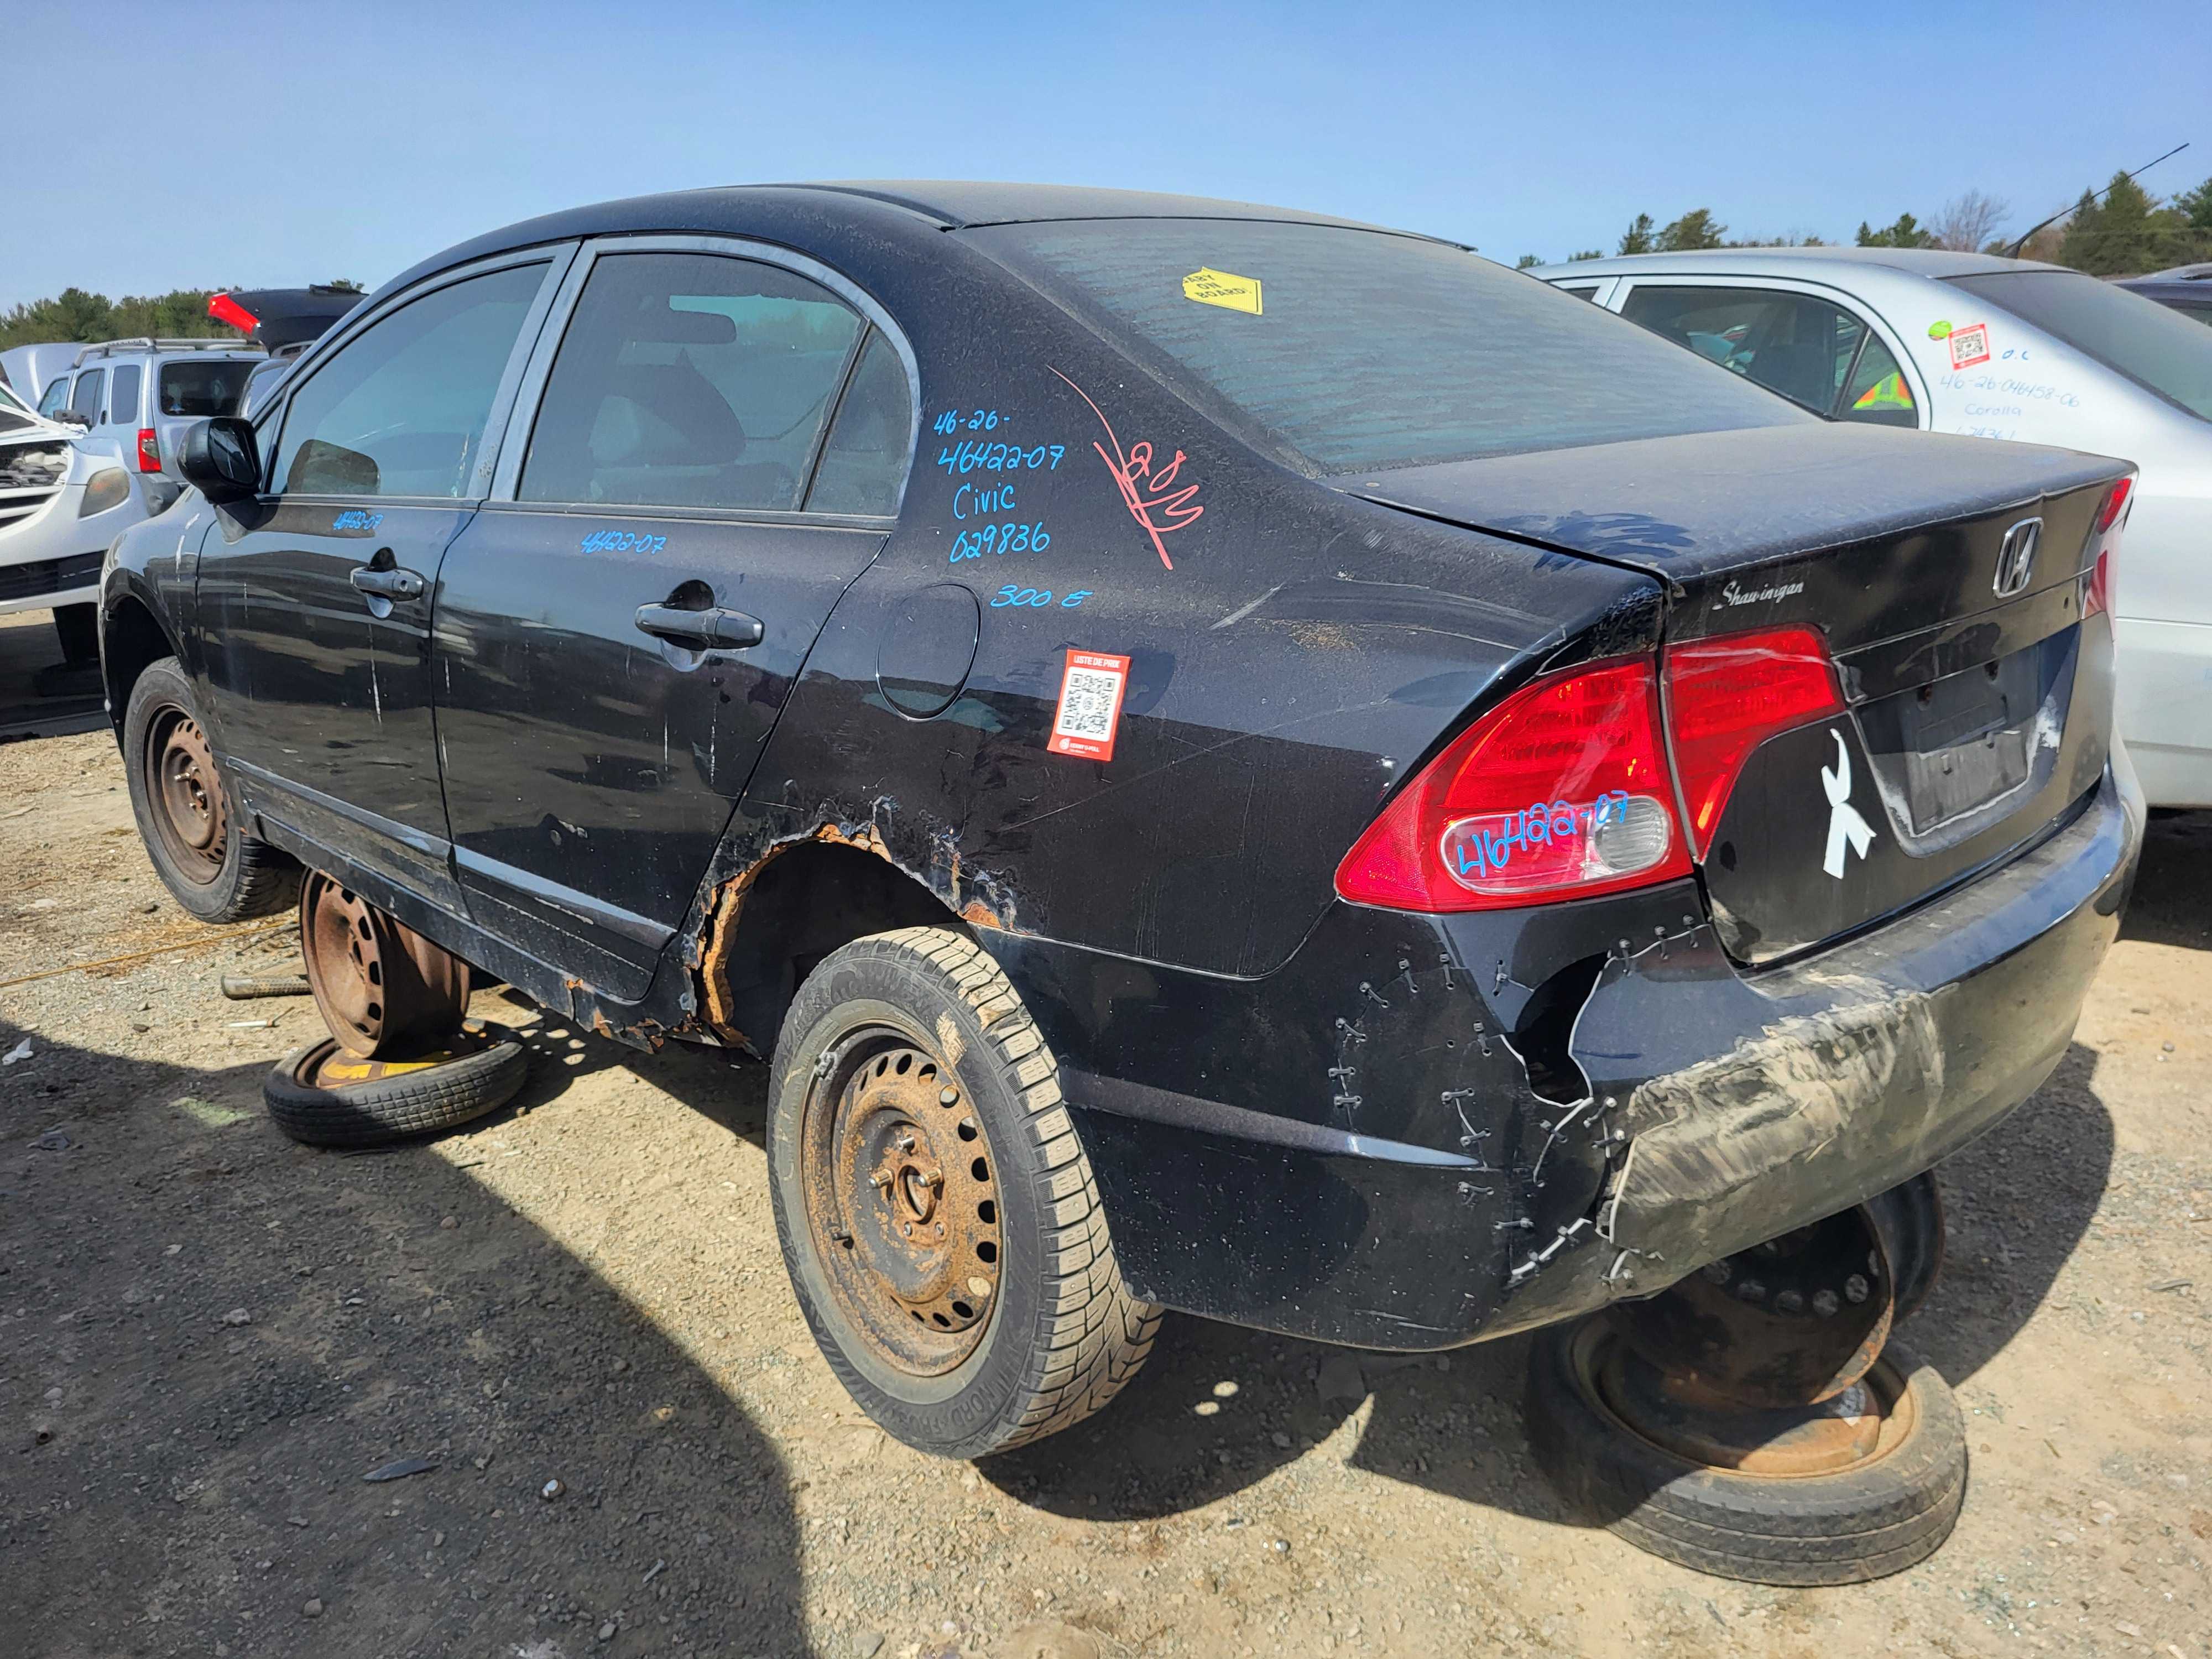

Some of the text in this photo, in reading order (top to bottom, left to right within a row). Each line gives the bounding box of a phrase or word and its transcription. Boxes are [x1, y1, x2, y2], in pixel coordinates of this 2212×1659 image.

[1964, 403, 2022, 416] Corolla
[937, 440, 1065, 476] 46422-07
[580, 530, 667, 555] 46422-07
[948, 521, 1052, 564] 029836
[989, 583, 1053, 609] 300
[1073, 654, 1121, 669] LISTE DE PRIX
[1457, 790, 1629, 877] 46422-07
